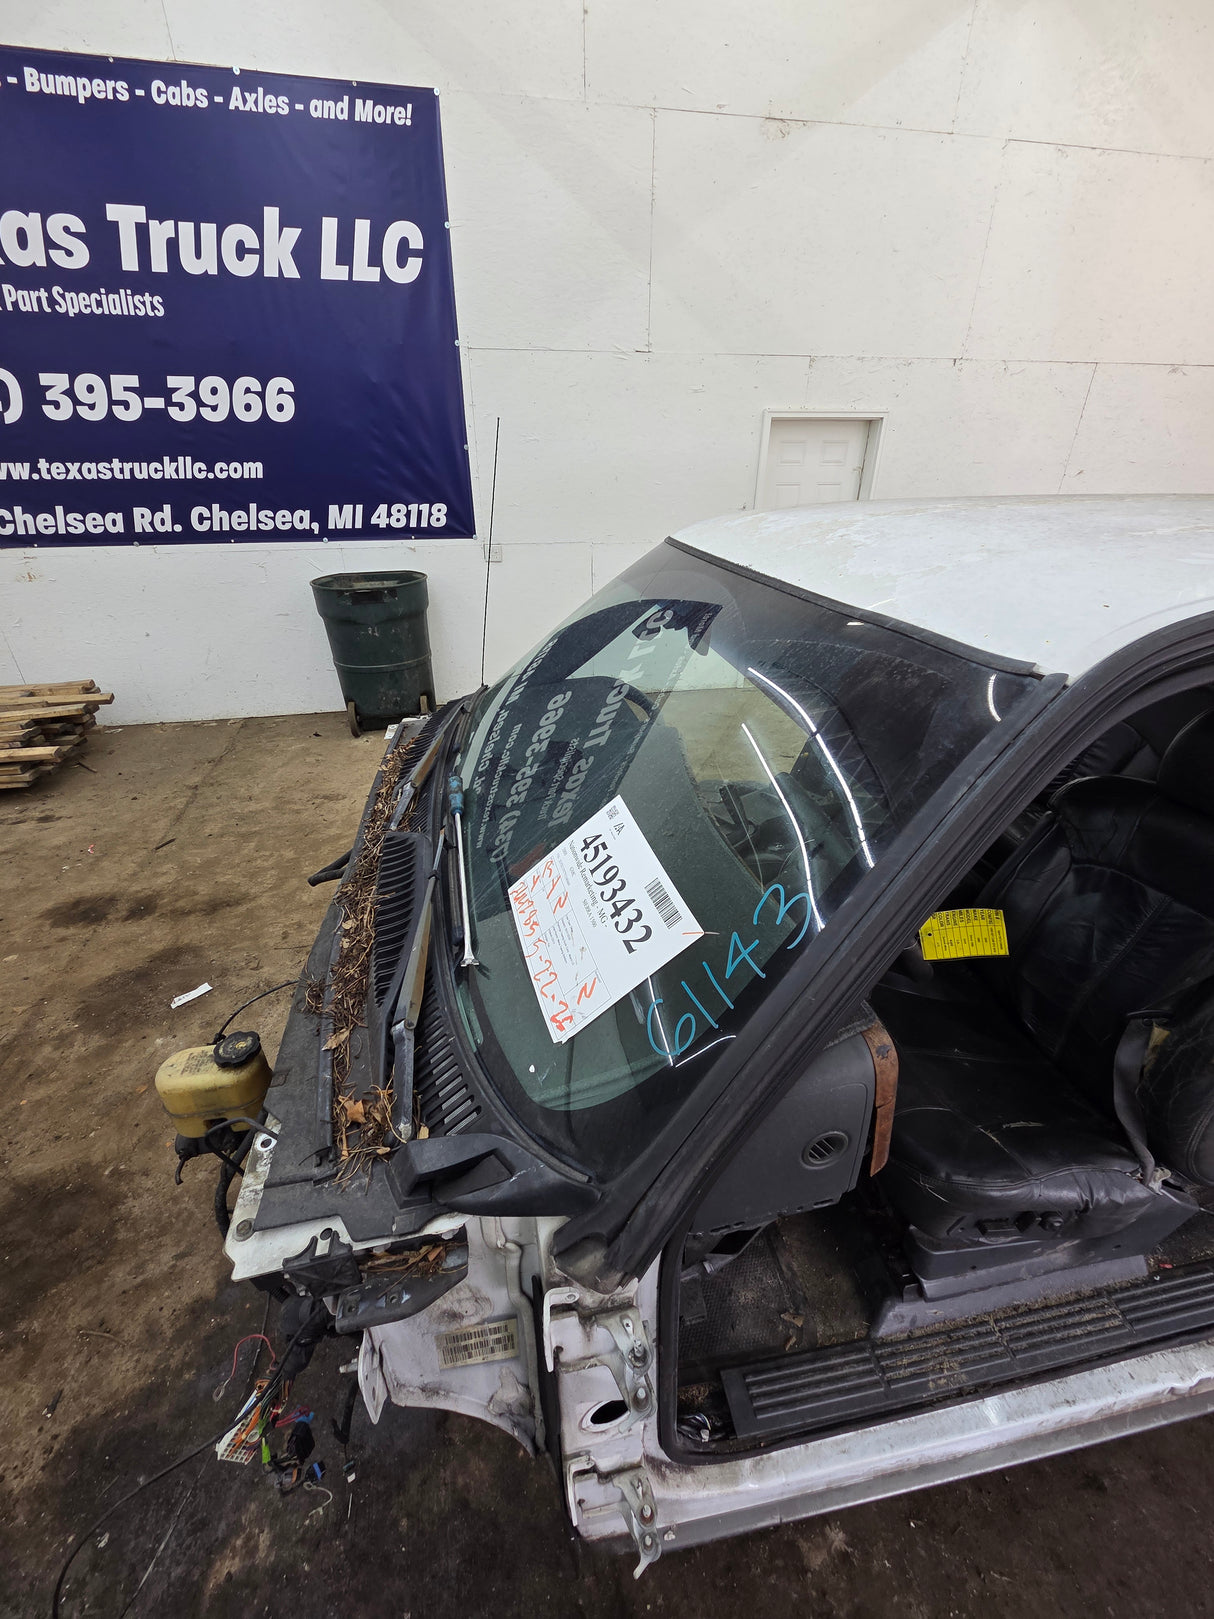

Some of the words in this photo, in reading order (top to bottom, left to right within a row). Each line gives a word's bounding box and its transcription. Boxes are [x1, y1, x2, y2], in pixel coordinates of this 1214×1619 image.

[23, 66, 130, 103] Bumpers
[151, 79, 209, 108] Cabs
[229, 86, 290, 115] Axles
[309, 95, 349, 121] and
[354, 99, 413, 126] More!
[0, 209, 90, 270] as
[105, 203, 303, 279] Truck
[320, 216, 425, 284] LLC
[1, 284, 51, 314] Part
[52, 285, 165, 318] Specialists
[38, 373, 296, 423] 395-3966
[0, 505, 124, 536] Chelsea
[134, 506, 182, 533] Rd.
[190, 503, 319, 535] Chelsea,
[328, 503, 363, 529] MI
[370, 502, 448, 528] 48118
[579, 868, 599, 908] Remarketing
[580, 833, 652, 954] 45193432
[646, 883, 811, 1056] 61143
